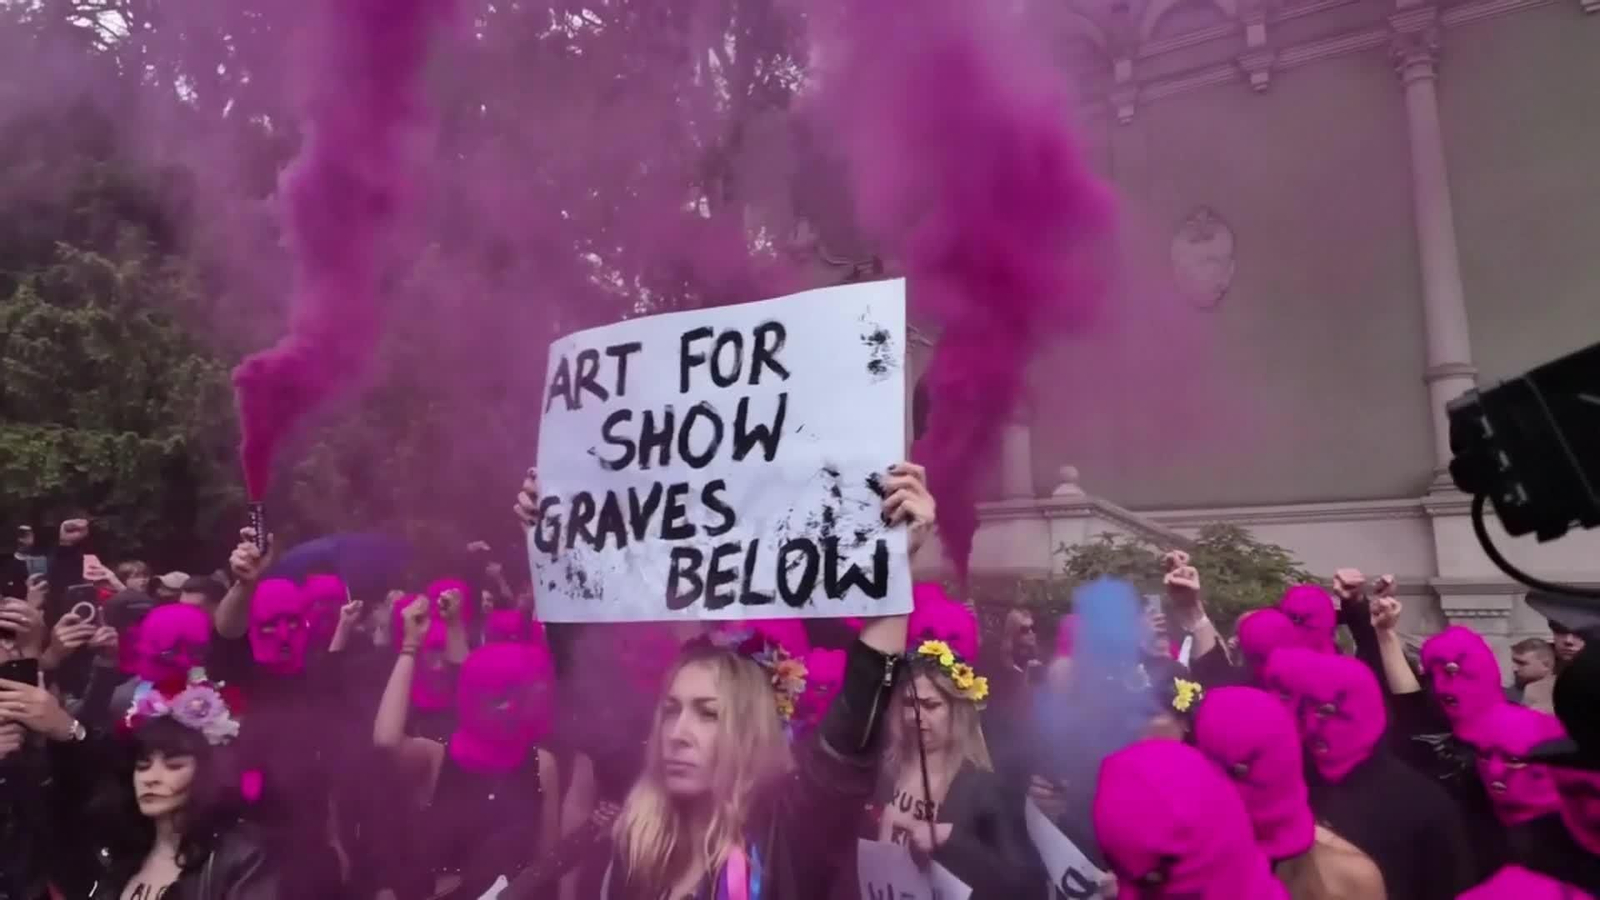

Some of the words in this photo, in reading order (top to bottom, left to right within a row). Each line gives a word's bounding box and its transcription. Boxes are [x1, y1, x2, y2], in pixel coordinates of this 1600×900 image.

[546, 342, 642, 413] ART
[680, 321, 790, 393] FOR
[598, 393, 788, 470] SHOW
[534, 479, 736, 553] GRAVES
[666, 537, 889, 610] BELOW
